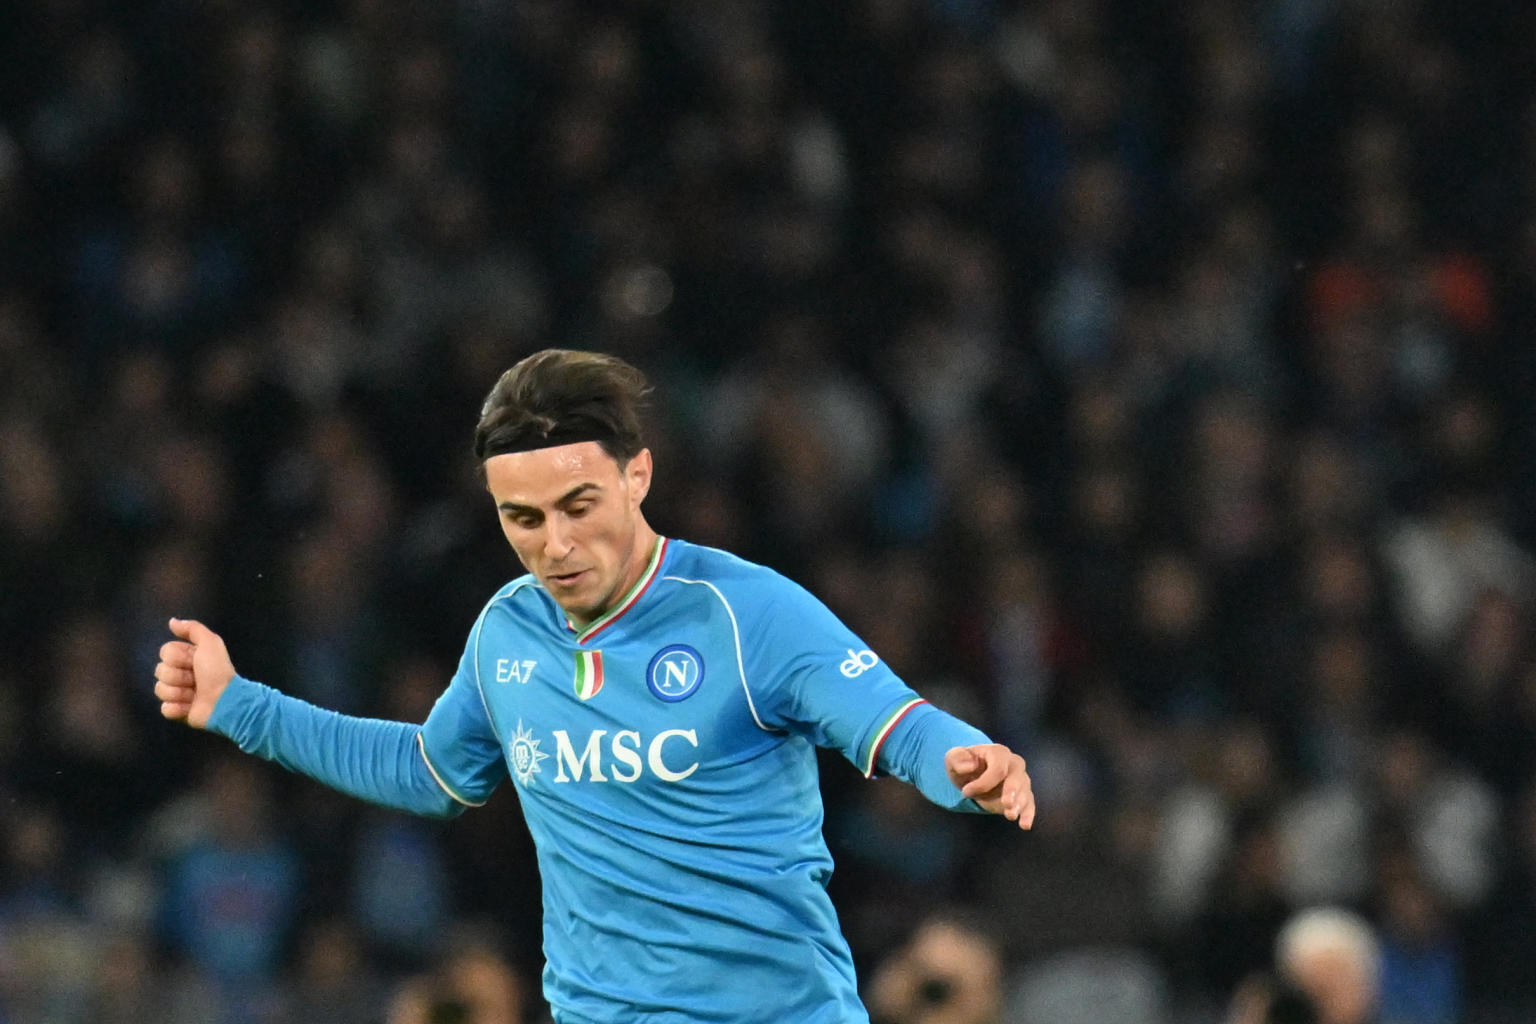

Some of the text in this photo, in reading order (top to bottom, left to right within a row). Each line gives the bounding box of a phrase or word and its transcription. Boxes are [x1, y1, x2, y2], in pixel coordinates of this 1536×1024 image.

[496, 659, 537, 684] EA7
[663, 660, 689, 688] N
[552, 729, 699, 783] MSC
